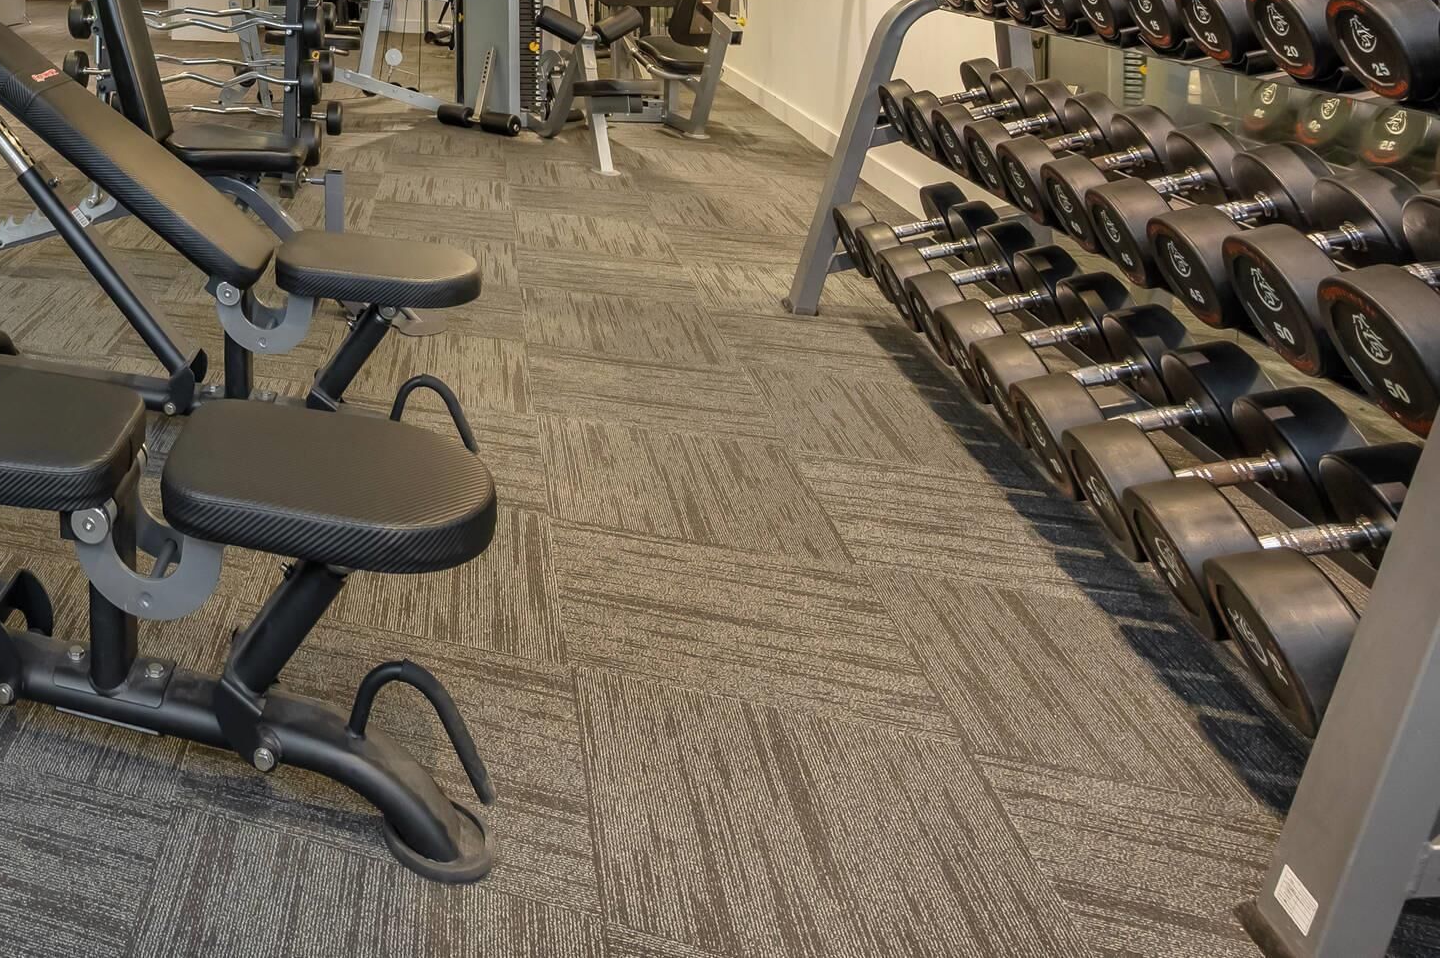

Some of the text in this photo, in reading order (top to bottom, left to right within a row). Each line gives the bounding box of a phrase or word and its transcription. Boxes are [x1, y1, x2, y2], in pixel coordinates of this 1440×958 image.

[1150, 20, 1161, 32] 15
[1204, 31, 1219, 45] 20
[1283, 44, 1299, 58] 20
[1372, 63, 1391, 77] 25
[1273, 321, 1295, 345] 50
[1383, 377, 1411, 405] 50
